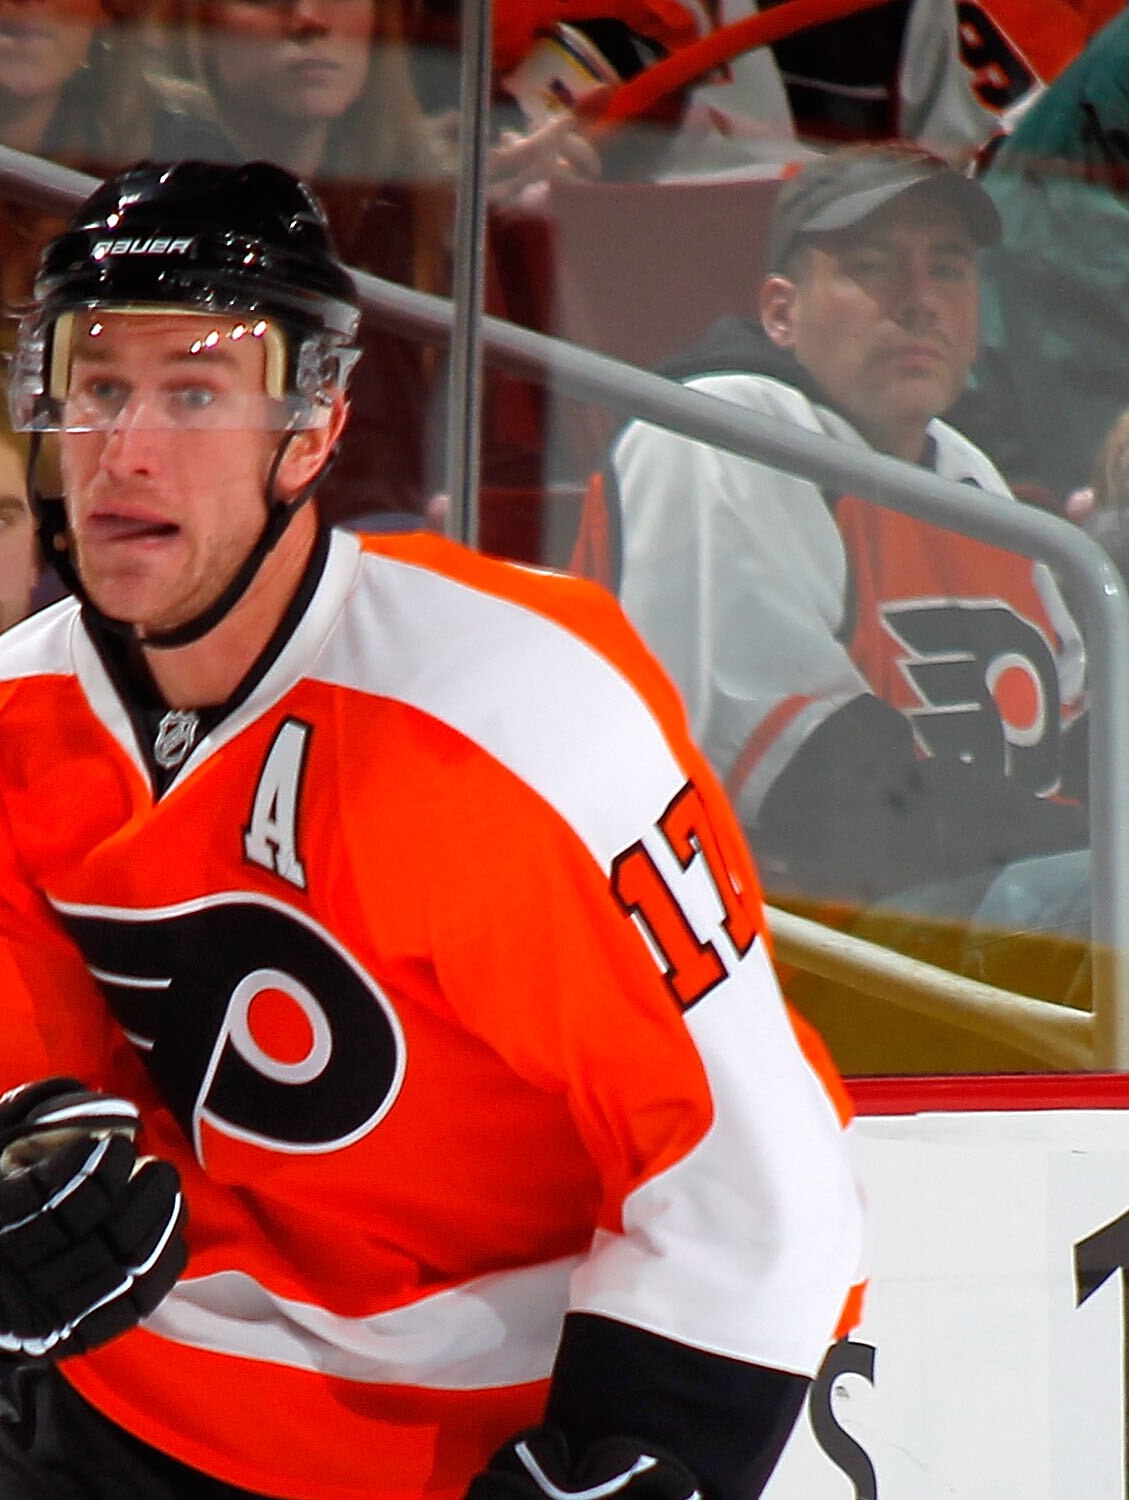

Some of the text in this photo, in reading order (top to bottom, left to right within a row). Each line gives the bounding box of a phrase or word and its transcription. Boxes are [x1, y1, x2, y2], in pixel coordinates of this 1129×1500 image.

[91, 236, 195, 259] BAUER
[241, 713, 314, 892] A
[610, 777, 759, 1012] 17
